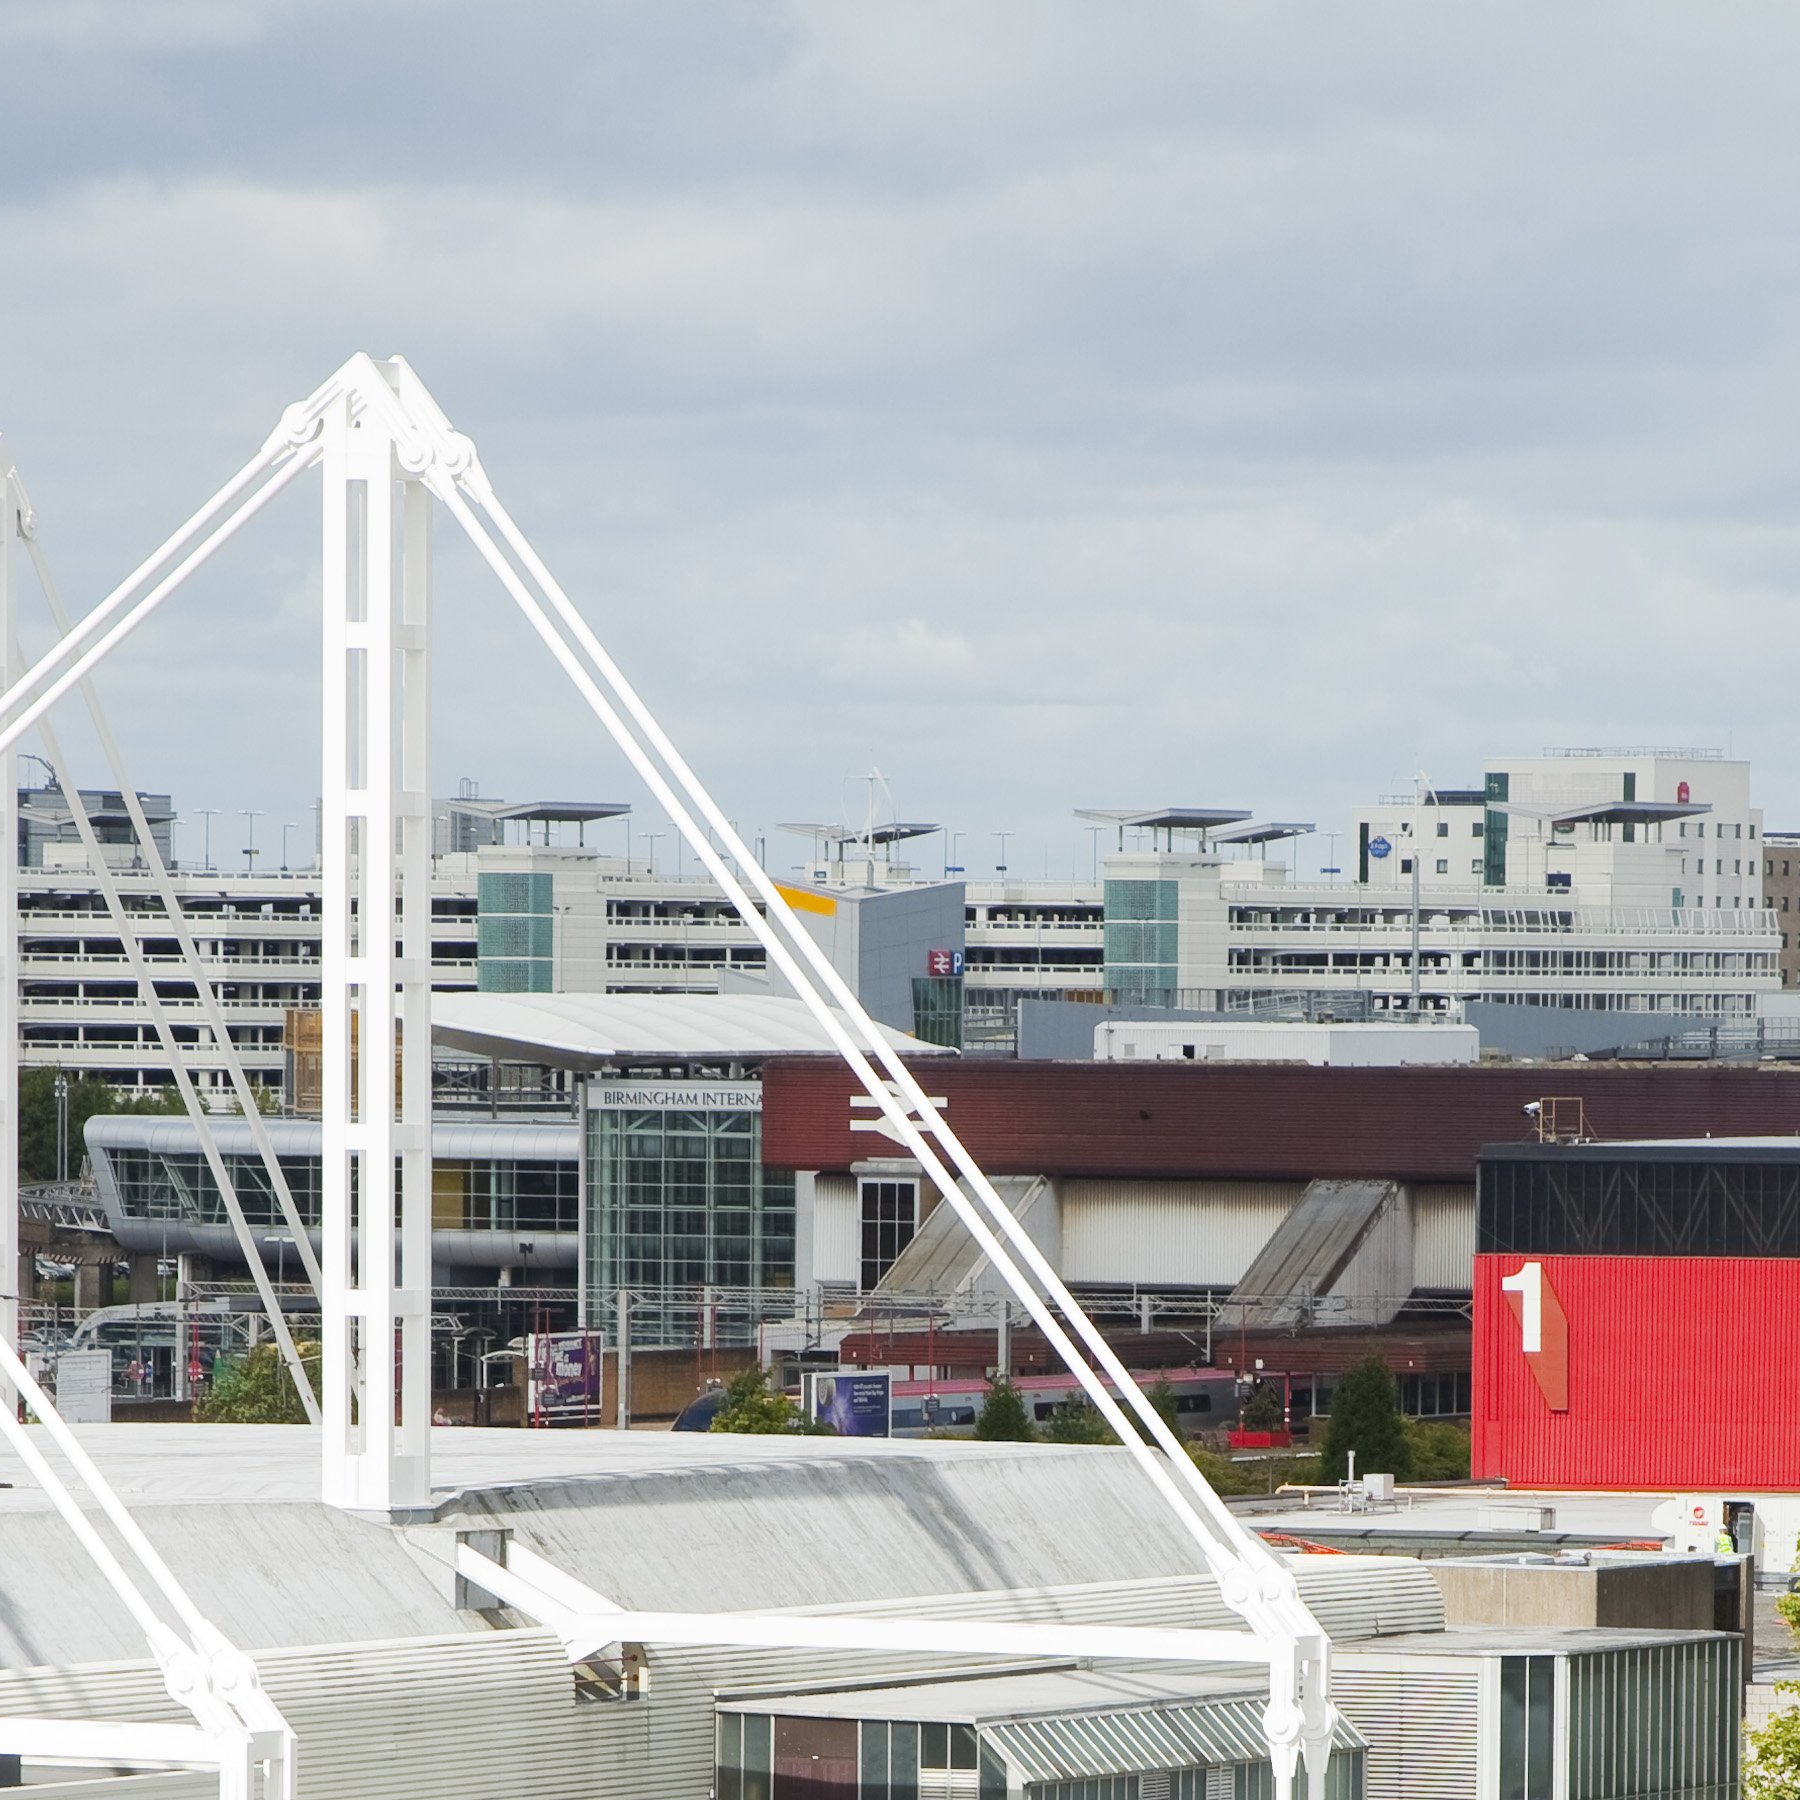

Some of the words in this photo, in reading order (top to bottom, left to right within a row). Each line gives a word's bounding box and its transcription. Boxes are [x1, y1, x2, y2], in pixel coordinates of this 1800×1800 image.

[953, 952, 963, 974] P
[604, 1091, 698, 1105] BIRMINGHAM
[1502, 1261, 1542, 1353] 1
